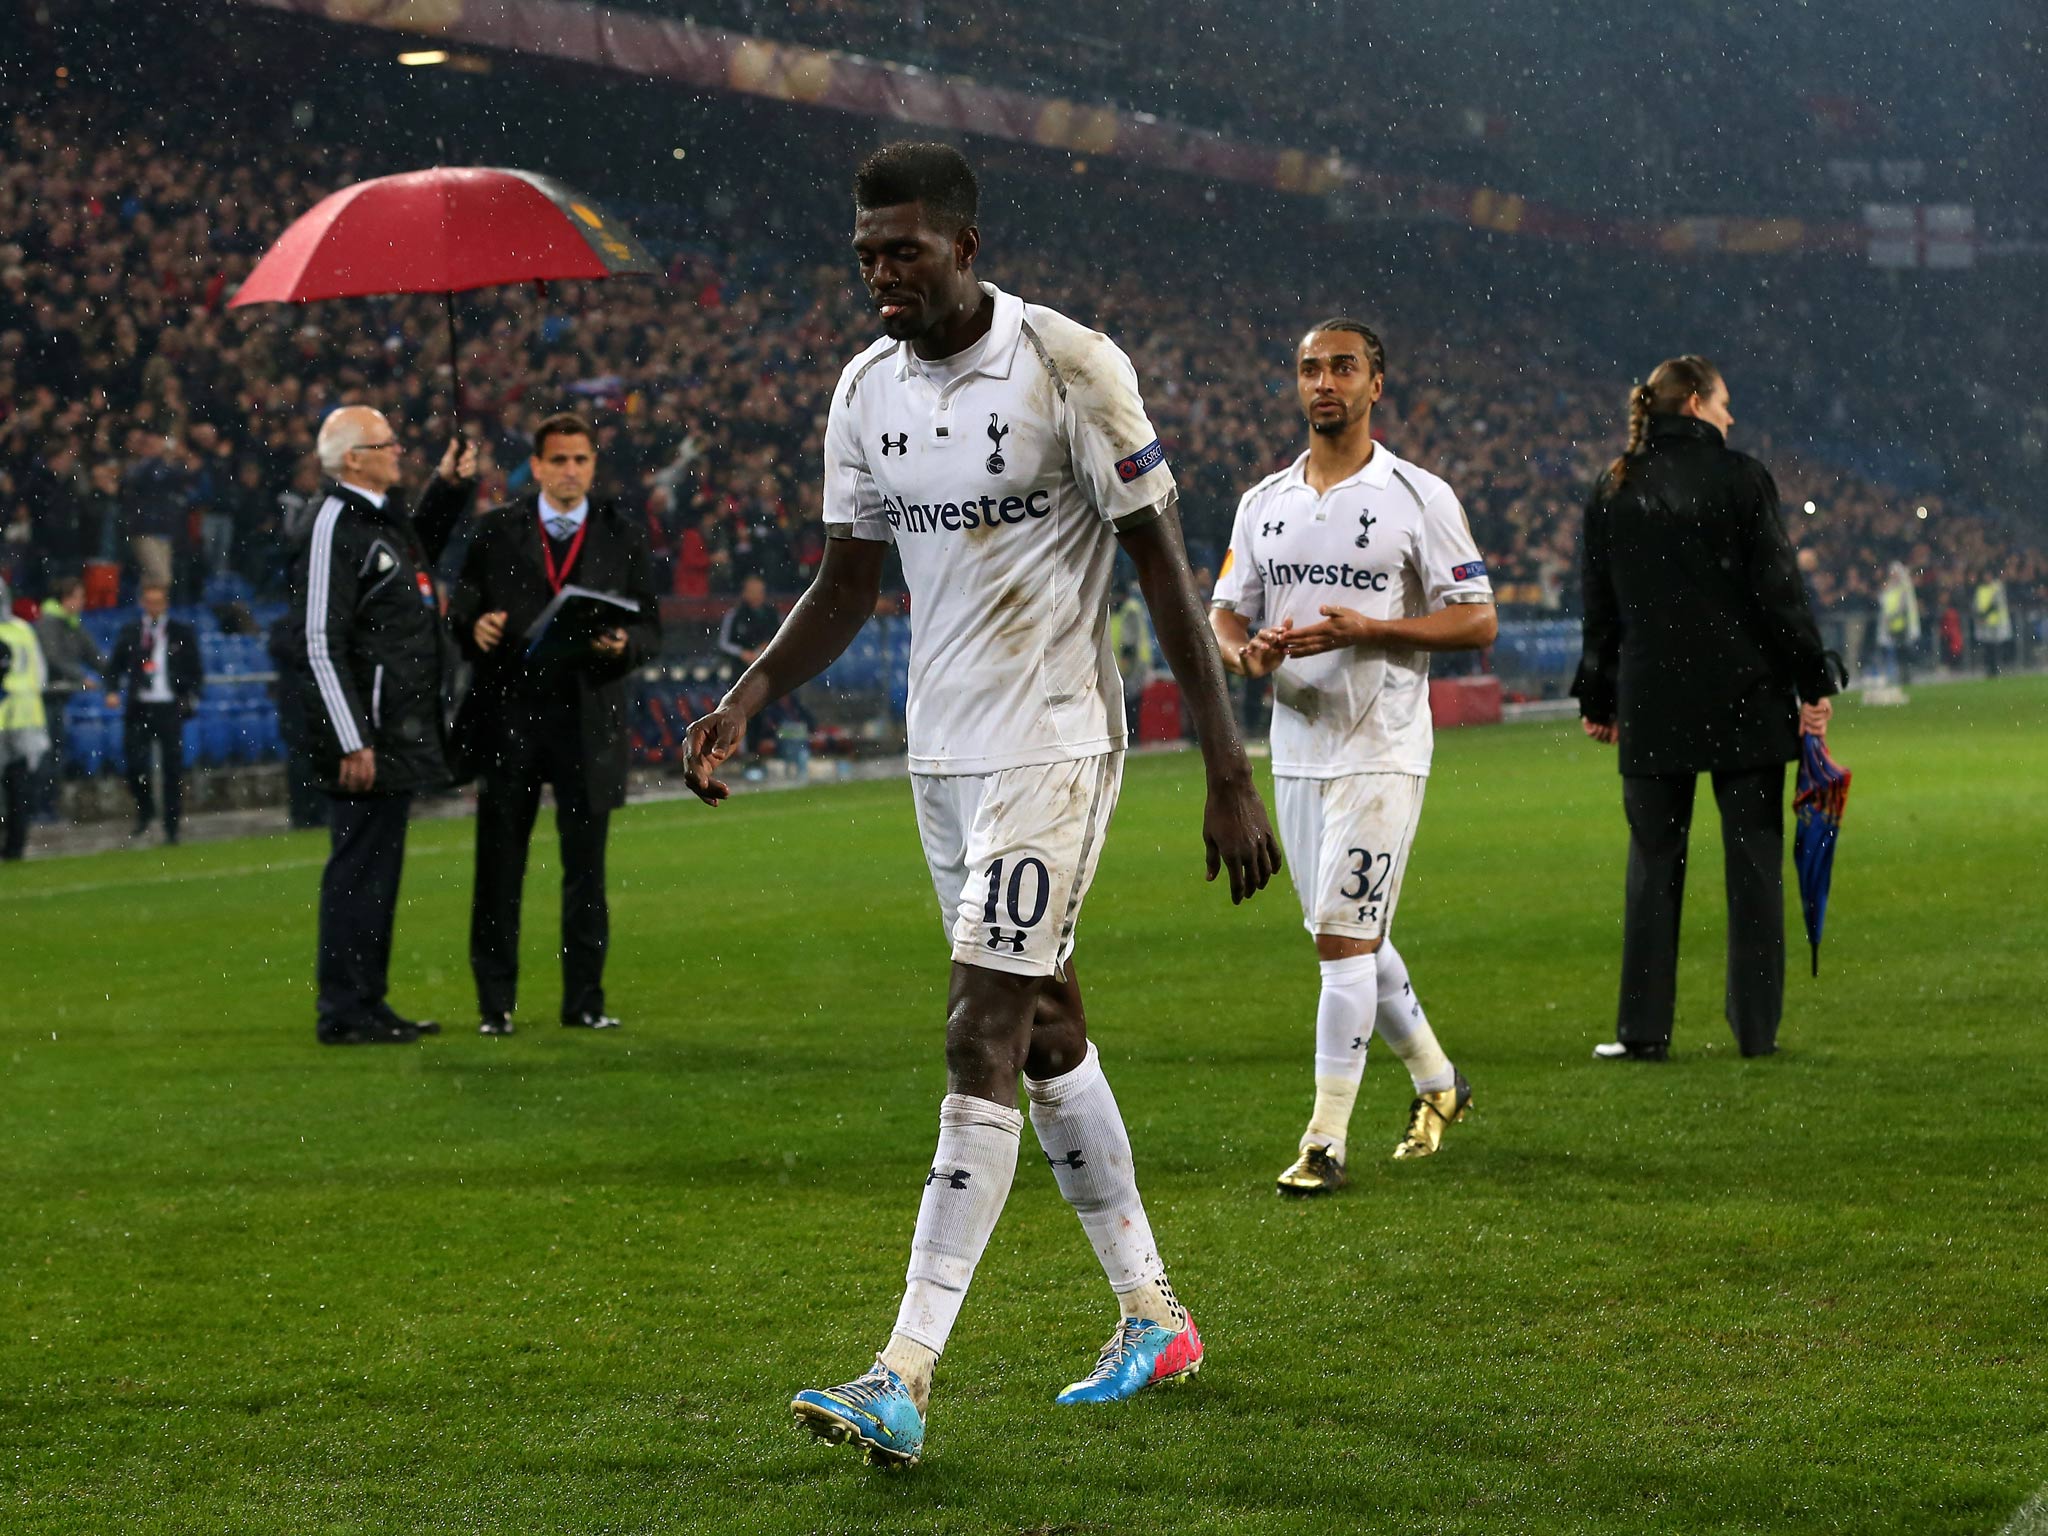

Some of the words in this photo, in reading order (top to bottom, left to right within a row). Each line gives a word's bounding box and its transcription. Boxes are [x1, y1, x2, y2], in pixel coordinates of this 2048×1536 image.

[895, 489, 1052, 534] Investec
[1268, 558, 1389, 592] Investec
[982, 857, 1050, 928] 10
[1340, 847, 1391, 903] 32
